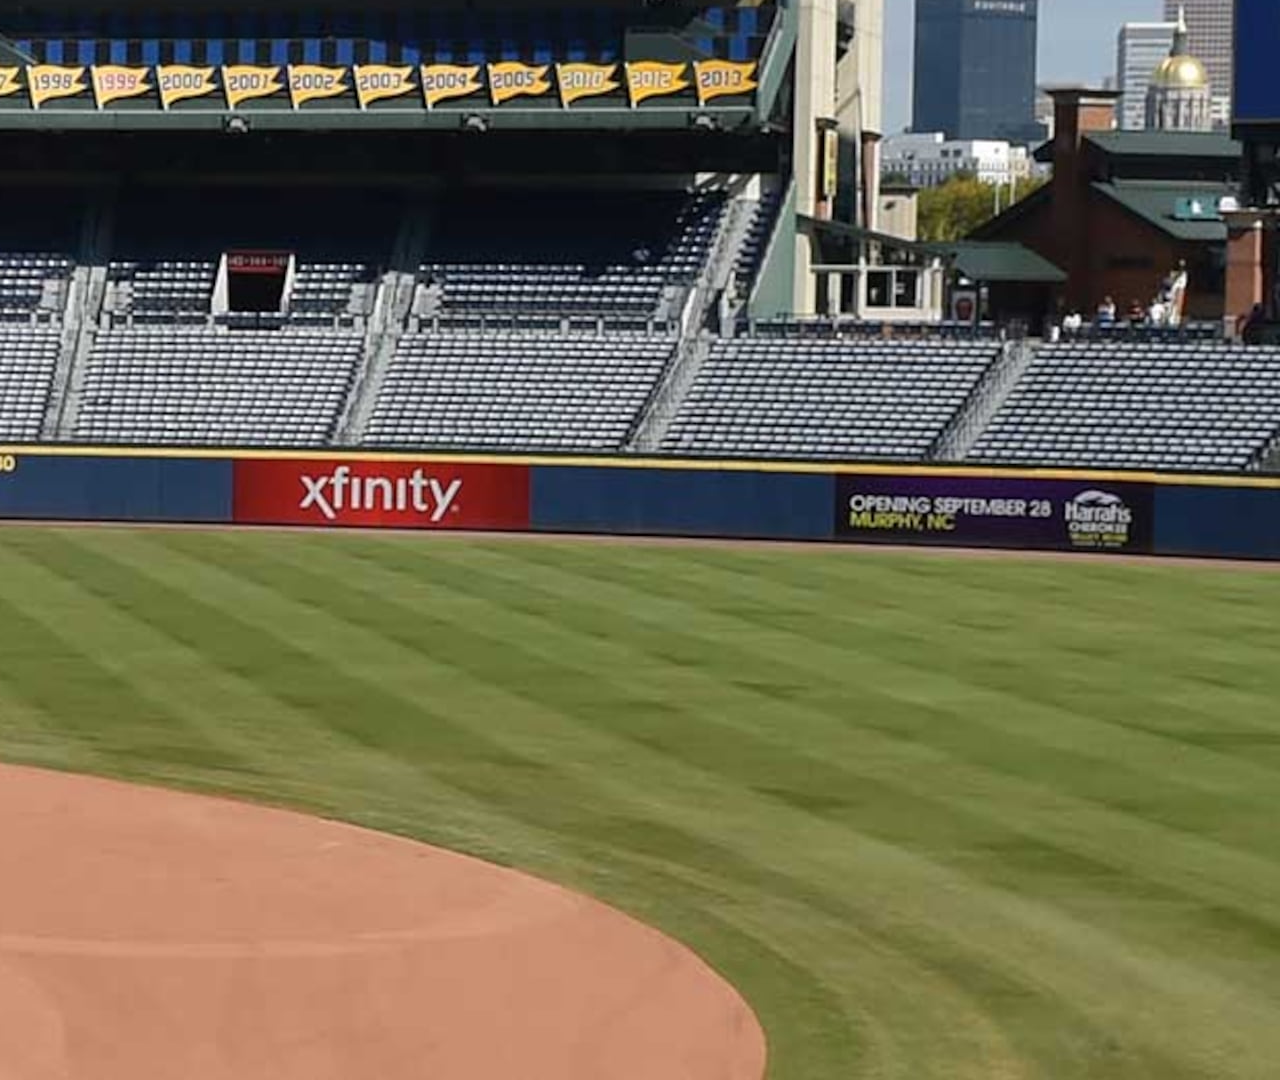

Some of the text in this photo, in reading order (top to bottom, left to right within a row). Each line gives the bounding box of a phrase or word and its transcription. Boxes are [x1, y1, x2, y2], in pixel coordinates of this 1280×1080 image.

[33, 73, 73, 89] 1998
[98, 73, 138, 90] 1999
[162, 73, 204, 90] 2000
[228, 73, 269, 90] 2001
[292, 73, 334, 90] 2002
[424, 73, 468, 89] 2004
[492, 71, 535, 88] 2005
[700, 70, 742, 87] 2013
[300, 465, 462, 521] xfinity
[849, 494, 1052, 518] OPENING SEPTEMBER 28
[849, 511, 955, 531] MURPHY, NC
